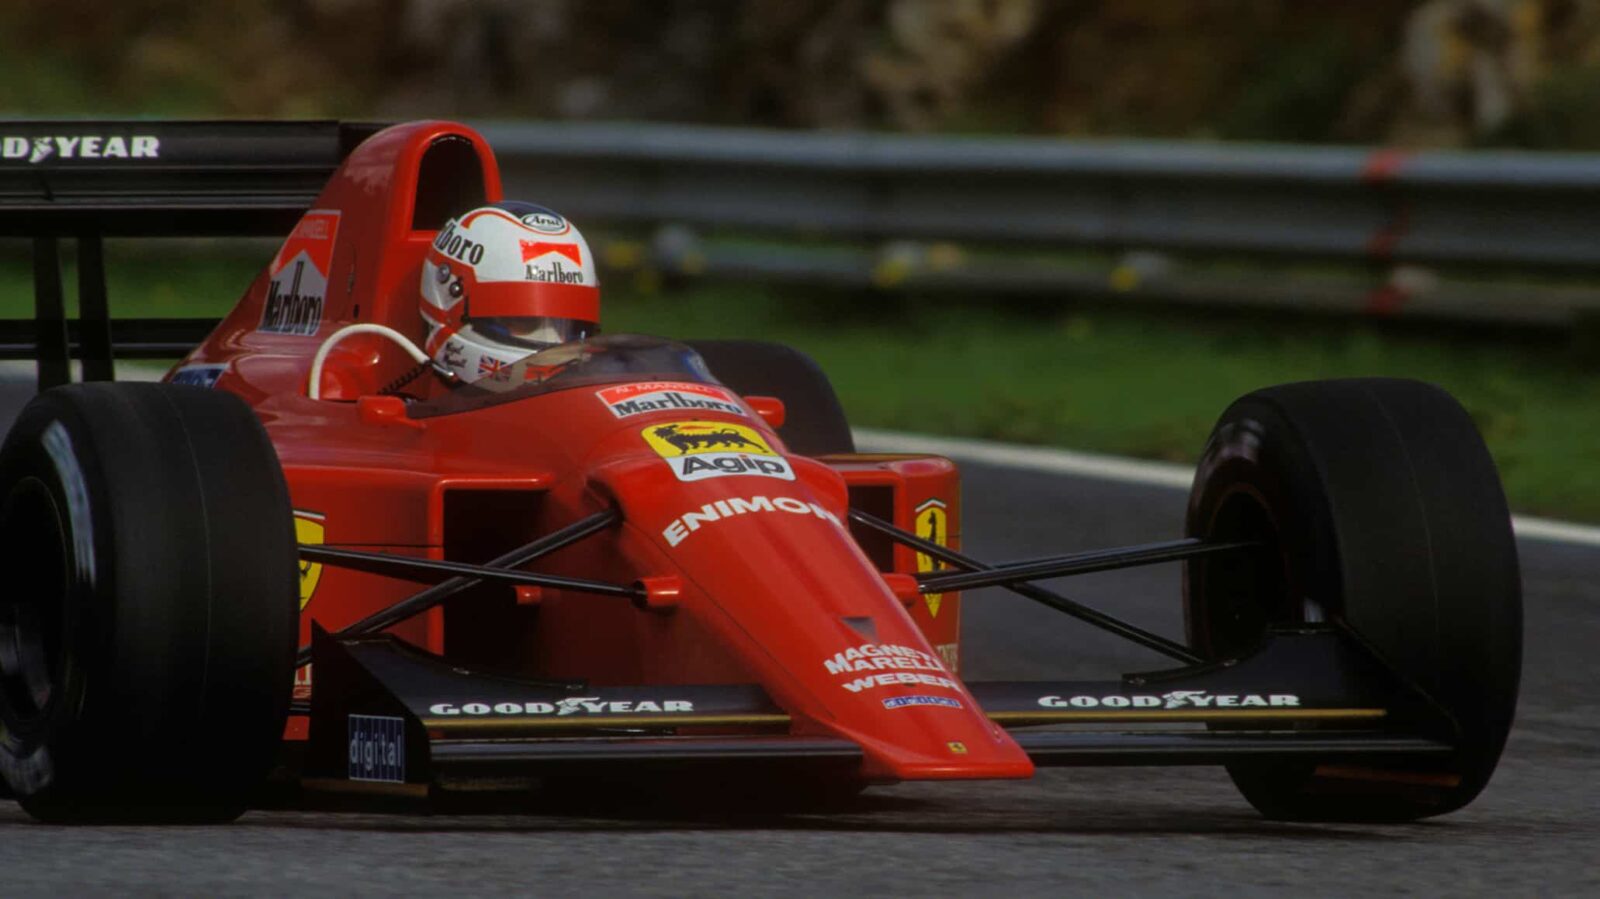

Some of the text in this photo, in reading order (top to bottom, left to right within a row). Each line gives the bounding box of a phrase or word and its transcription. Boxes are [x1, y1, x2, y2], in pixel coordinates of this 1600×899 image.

[0, 135, 160, 163] DYEAR
[525, 261, 583, 284] Marlboro
[614, 392, 742, 418] Marlboro
[682, 454, 786, 476] Agip
[350, 730, 402, 772] digital
